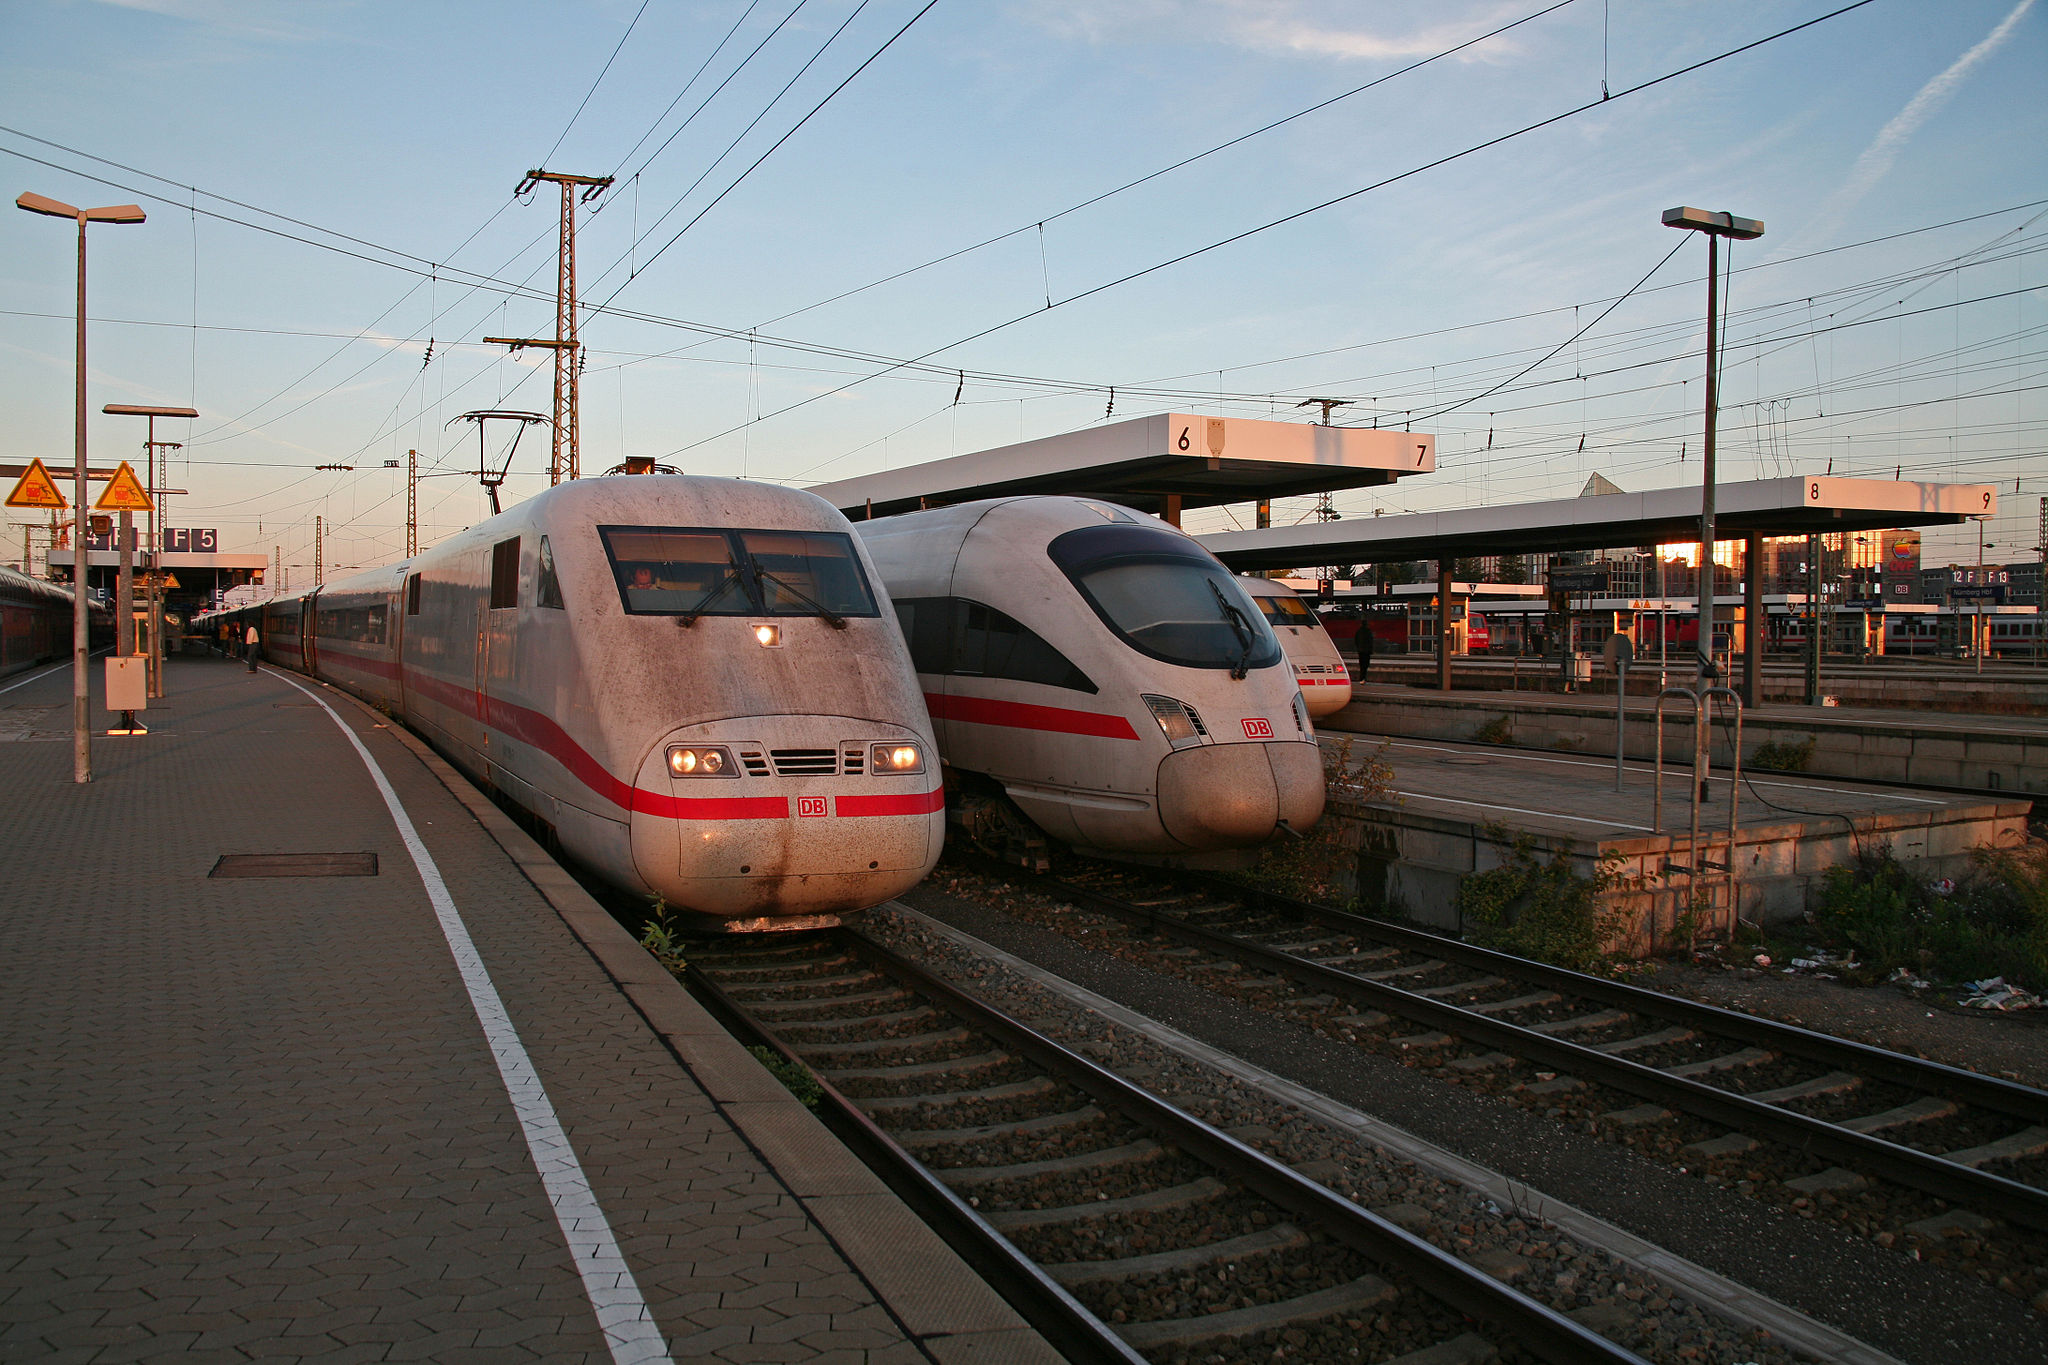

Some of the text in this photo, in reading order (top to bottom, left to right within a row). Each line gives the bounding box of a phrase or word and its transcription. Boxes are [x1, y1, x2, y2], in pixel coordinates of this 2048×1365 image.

[1177, 426, 1190, 451] 6
[1416, 444, 1427, 467] 7
[1810, 482, 1819, 500] 8
[1982, 492, 1991, 510] 9
[173, 529, 214, 548] F 5
[1952, 571, 1974, 583] 12 F
[1988, 571, 2007, 583] F 13
[97, 588, 105, 599] E
[1320, 580, 1328, 593] F
[1383, 581, 1391, 594] F
[1896, 585, 1907, 593] DB
[215, 589, 223, 600] E
[1244, 720, 1271, 736] DB
[800, 798, 826, 815] DB
